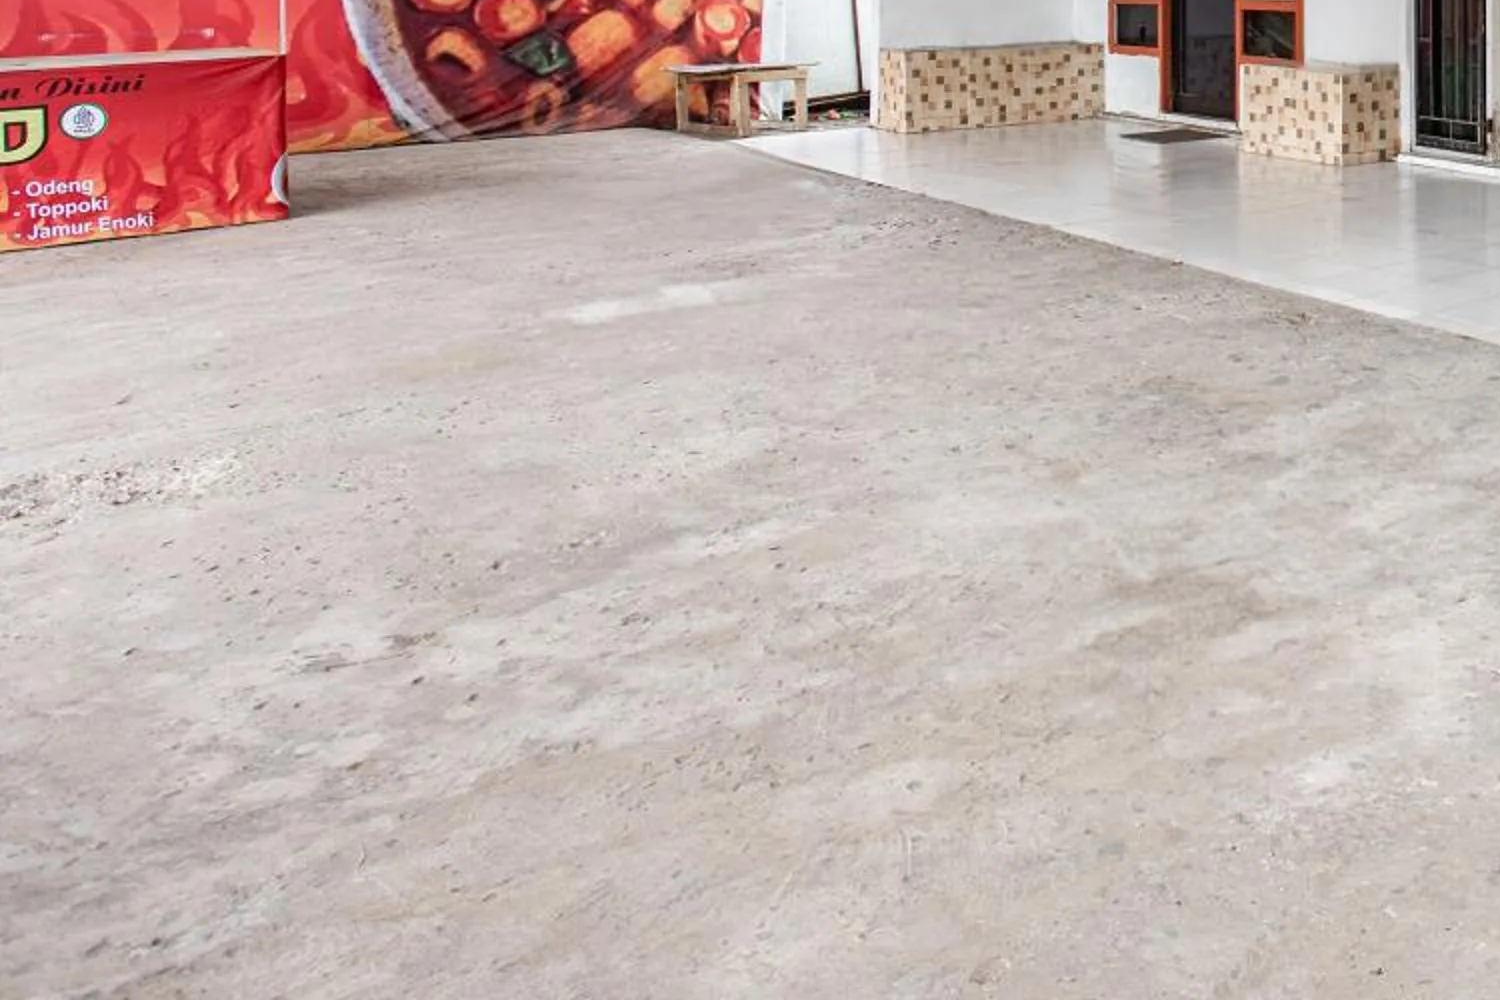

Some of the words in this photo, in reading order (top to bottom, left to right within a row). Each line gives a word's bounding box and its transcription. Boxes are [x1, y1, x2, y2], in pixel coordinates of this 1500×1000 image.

[35, 74, 146, 98] Disini
[26, 179, 94, 197] Odeng
[26, 195, 109, 219] Toppoki
[28, 222, 93, 241] Jamur
[100, 212, 154, 232] Enoki
